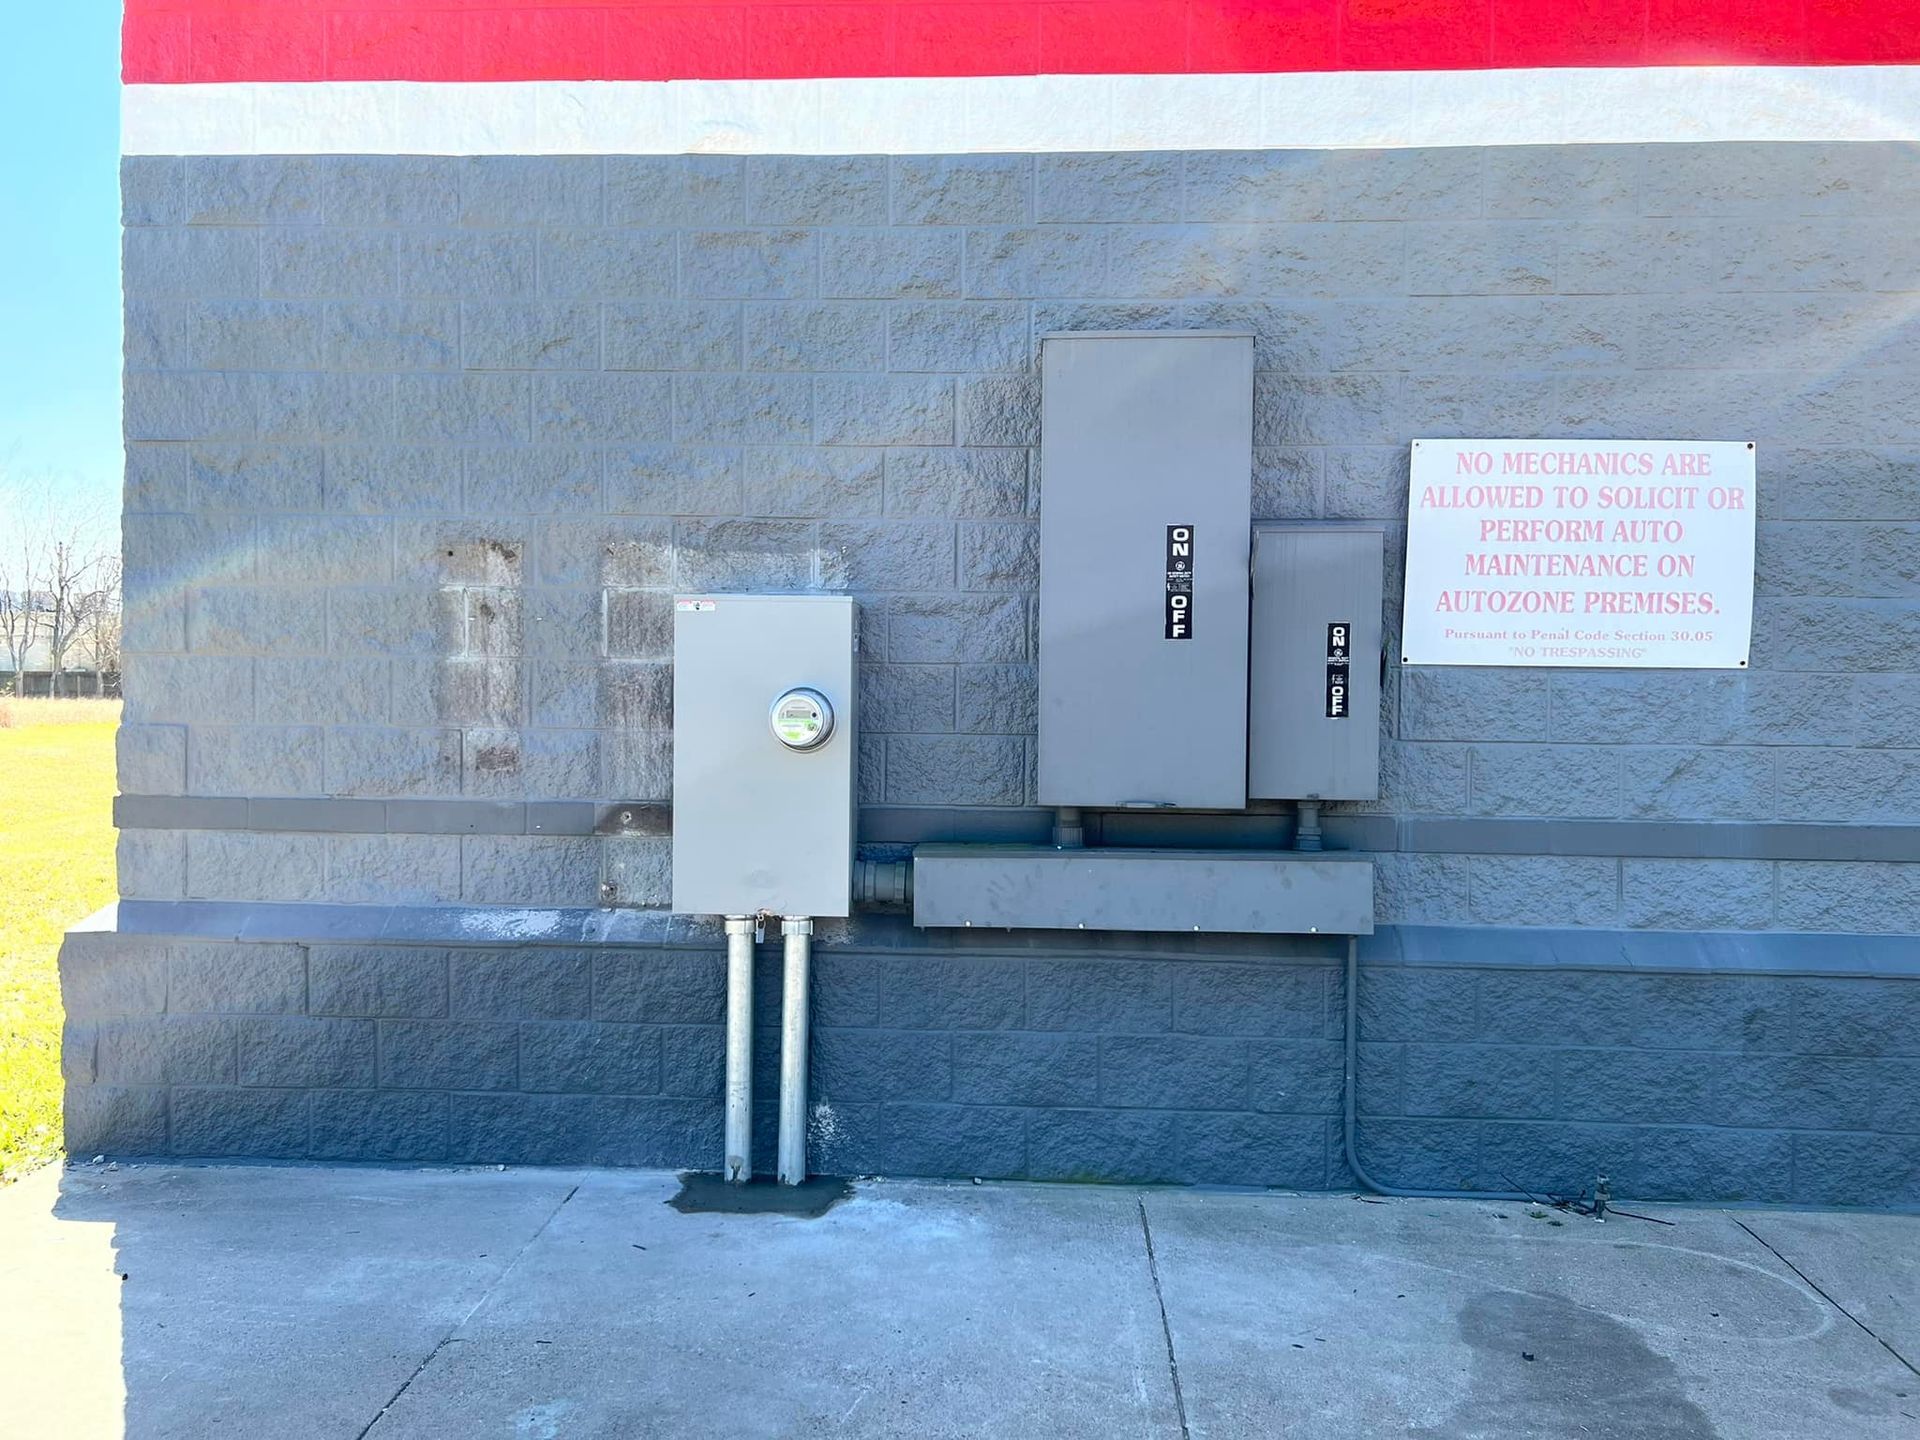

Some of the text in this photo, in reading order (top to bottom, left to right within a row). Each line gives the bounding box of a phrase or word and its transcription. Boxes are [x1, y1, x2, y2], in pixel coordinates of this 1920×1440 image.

[1456, 452, 1712, 476] NO MECHANICS ARE
[1420, 485, 1745, 510] ALLOWED TO SOLICIT OR
[1172, 528, 1189, 556] ON
[1480, 519, 1684, 543] PERFORM AUTO
[1465, 554, 1696, 578] MAINTENANCE ON
[1435, 590, 1720, 615] AUTOZONE PREMISES.
[1171, 595, 1188, 638] OFF
[1332, 626, 1346, 647] ON
[1445, 629, 1713, 641] Pursuant to Penal Code Section 30.05
[1331, 686, 1345, 716] OFF
